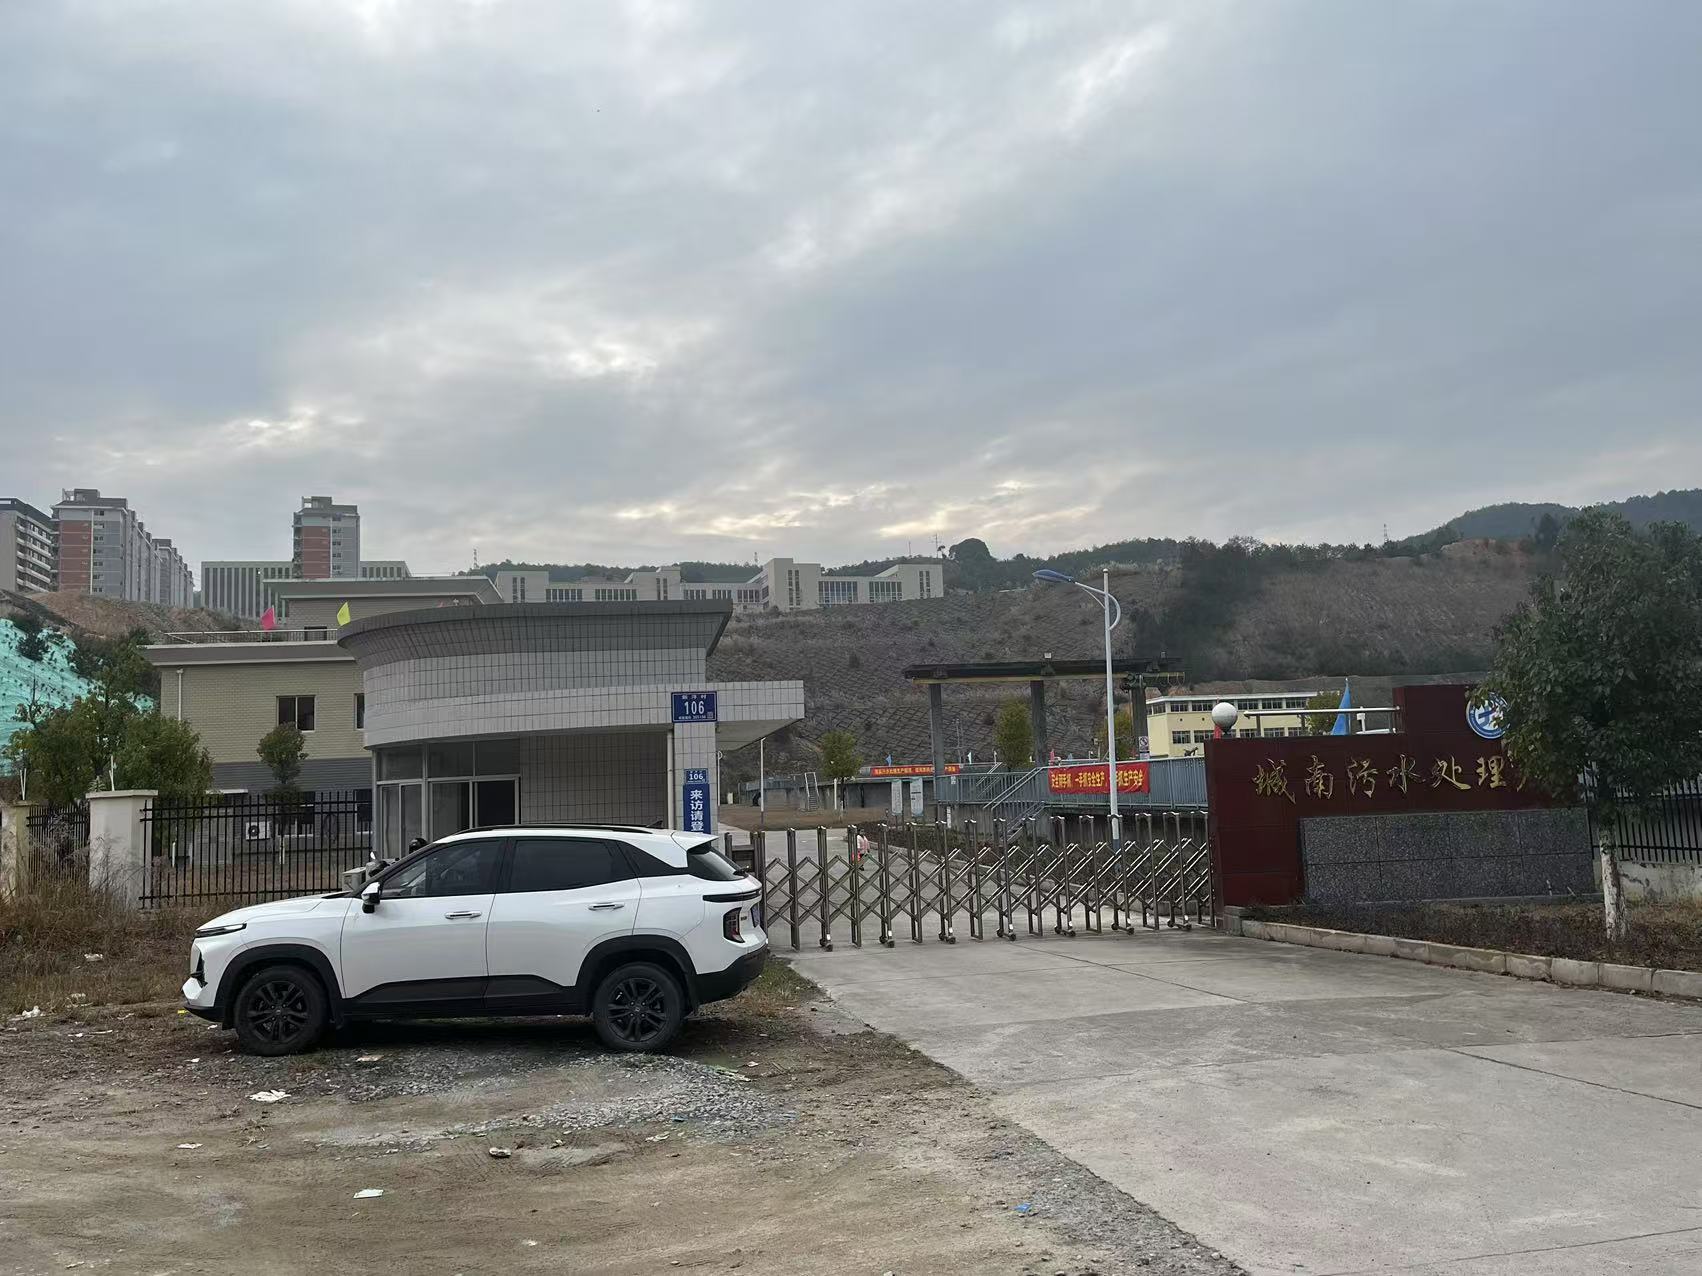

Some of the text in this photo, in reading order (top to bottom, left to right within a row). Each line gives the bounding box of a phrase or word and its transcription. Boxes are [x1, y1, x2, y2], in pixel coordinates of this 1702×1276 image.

[684, 700, 705, 715] 106
[1252, 754, 1527, 804] 城南污水处理
